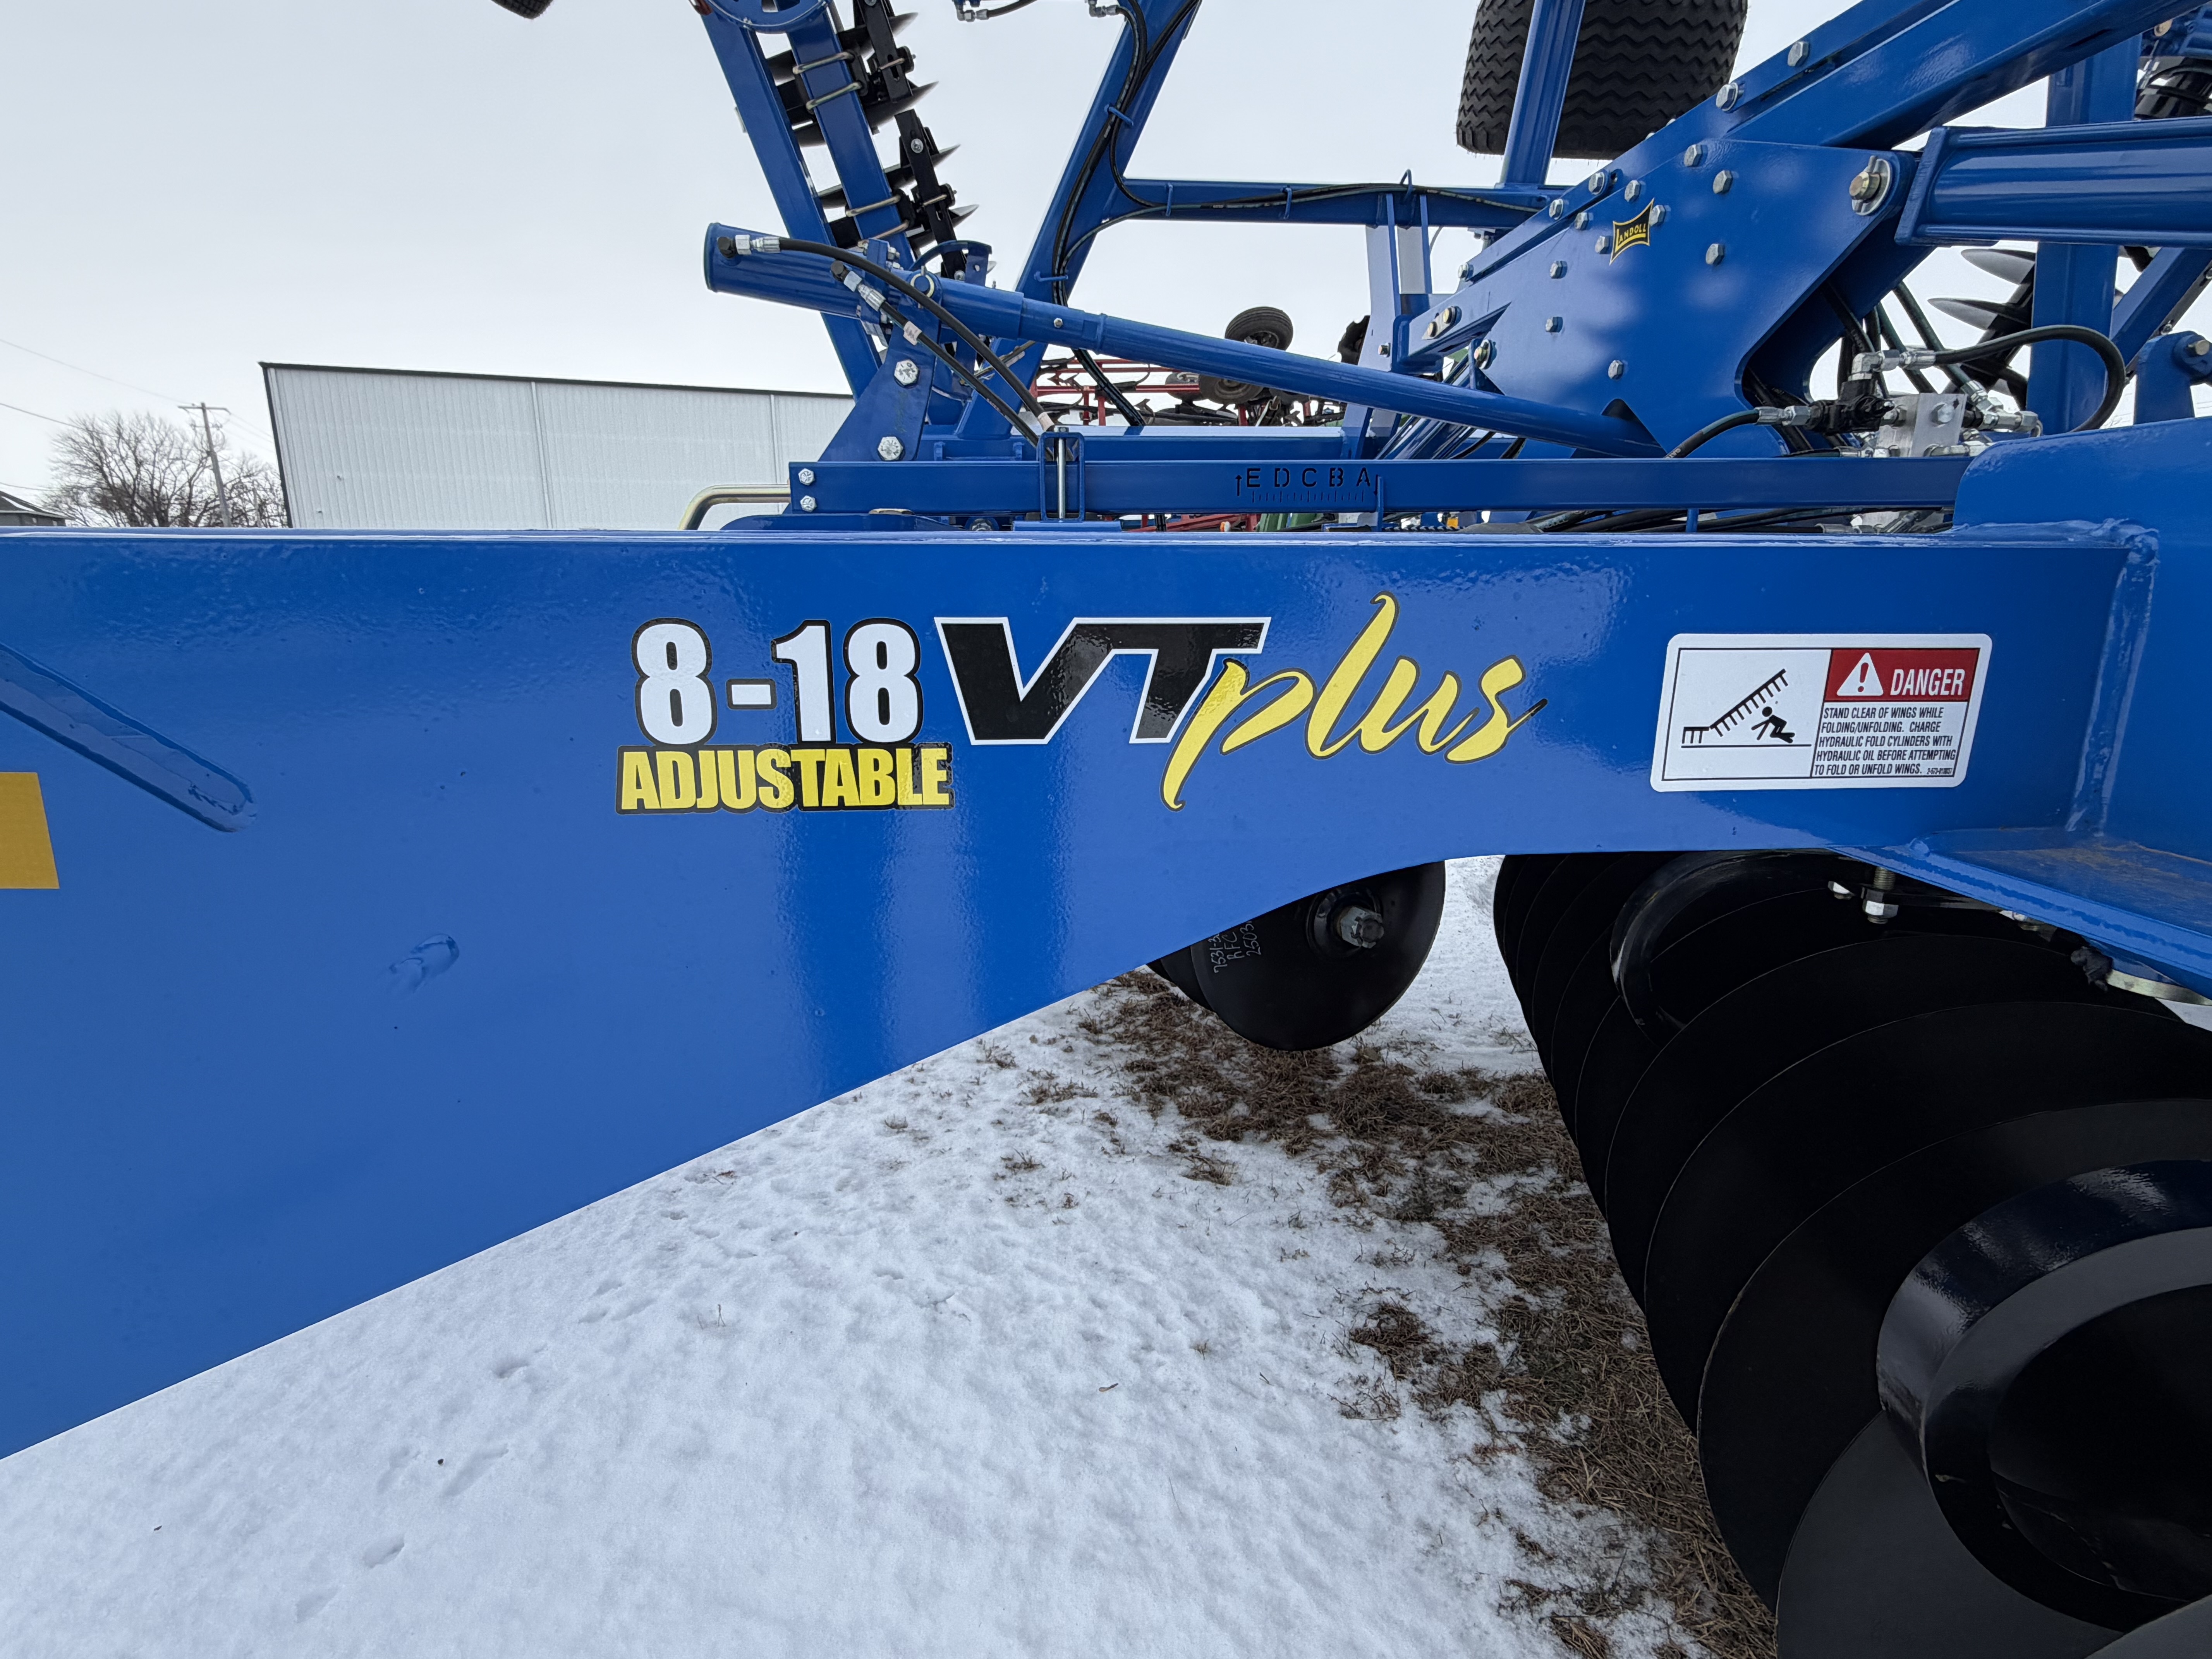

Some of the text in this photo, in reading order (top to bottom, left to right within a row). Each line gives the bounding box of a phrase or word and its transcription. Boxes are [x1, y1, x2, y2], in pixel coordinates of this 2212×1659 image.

[1615, 223, 1646, 252] LANDOLL
[1247, 467, 1370, 487] E D C B A
[633, 619, 923, 745] 8-18
[1890, 668, 1965, 696] DANGER
[933, 593, 1548, 811] VT plus
[1824, 707, 1944, 718] STAND CLEAR OF WINGS WHILE
[1821, 721, 1941, 734] FOLDING/UNFOLDING. CHARGE
[1819, 735, 1953, 747] HYDRAULIC FOLD CYLINDERS WITH
[1816, 749, 1956, 761] HYDRAULIC OIL BEFORE ATTEMPTING
[617, 744, 953, 813] ADJUSTABLE
[1815, 764, 1824, 775] TO
[1826, 764, 1846, 775] FOLD
[1848, 764, 1860, 775] OR
[1862, 764, 1893, 775] UNFOLD
[1895, 763, 1922, 774] WINGS.
[1208, 934, 1228, 973] 7531-3
